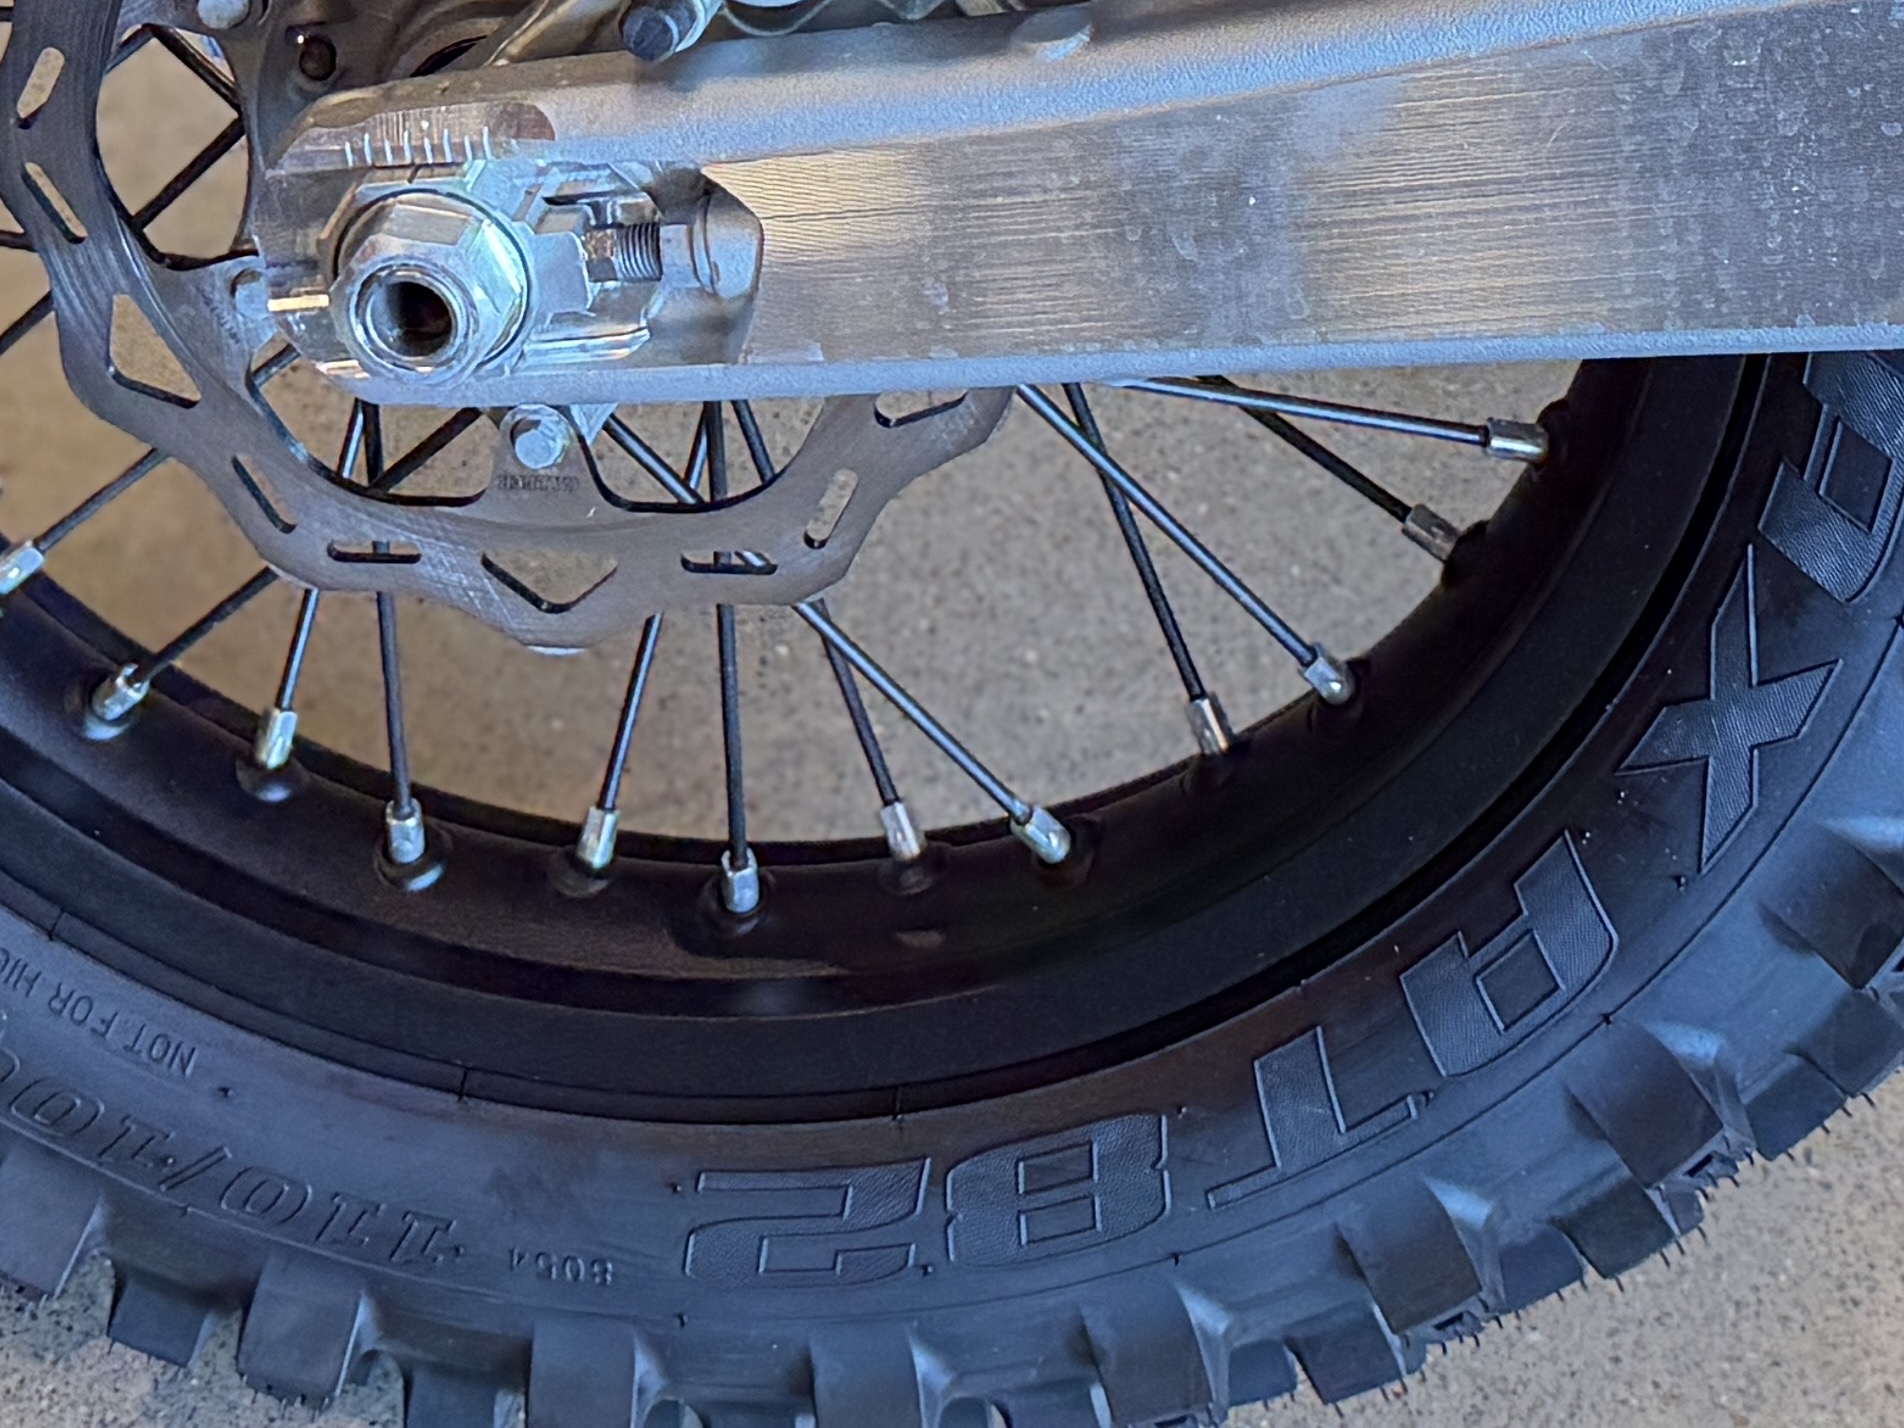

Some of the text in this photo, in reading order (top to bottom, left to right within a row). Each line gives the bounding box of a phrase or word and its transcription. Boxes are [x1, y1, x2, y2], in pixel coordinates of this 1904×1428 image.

[46, 980, 128, 1044] FOR
[124, 1024, 198, 1076] NOT
[686, 831, 1617, 1289] AT82
